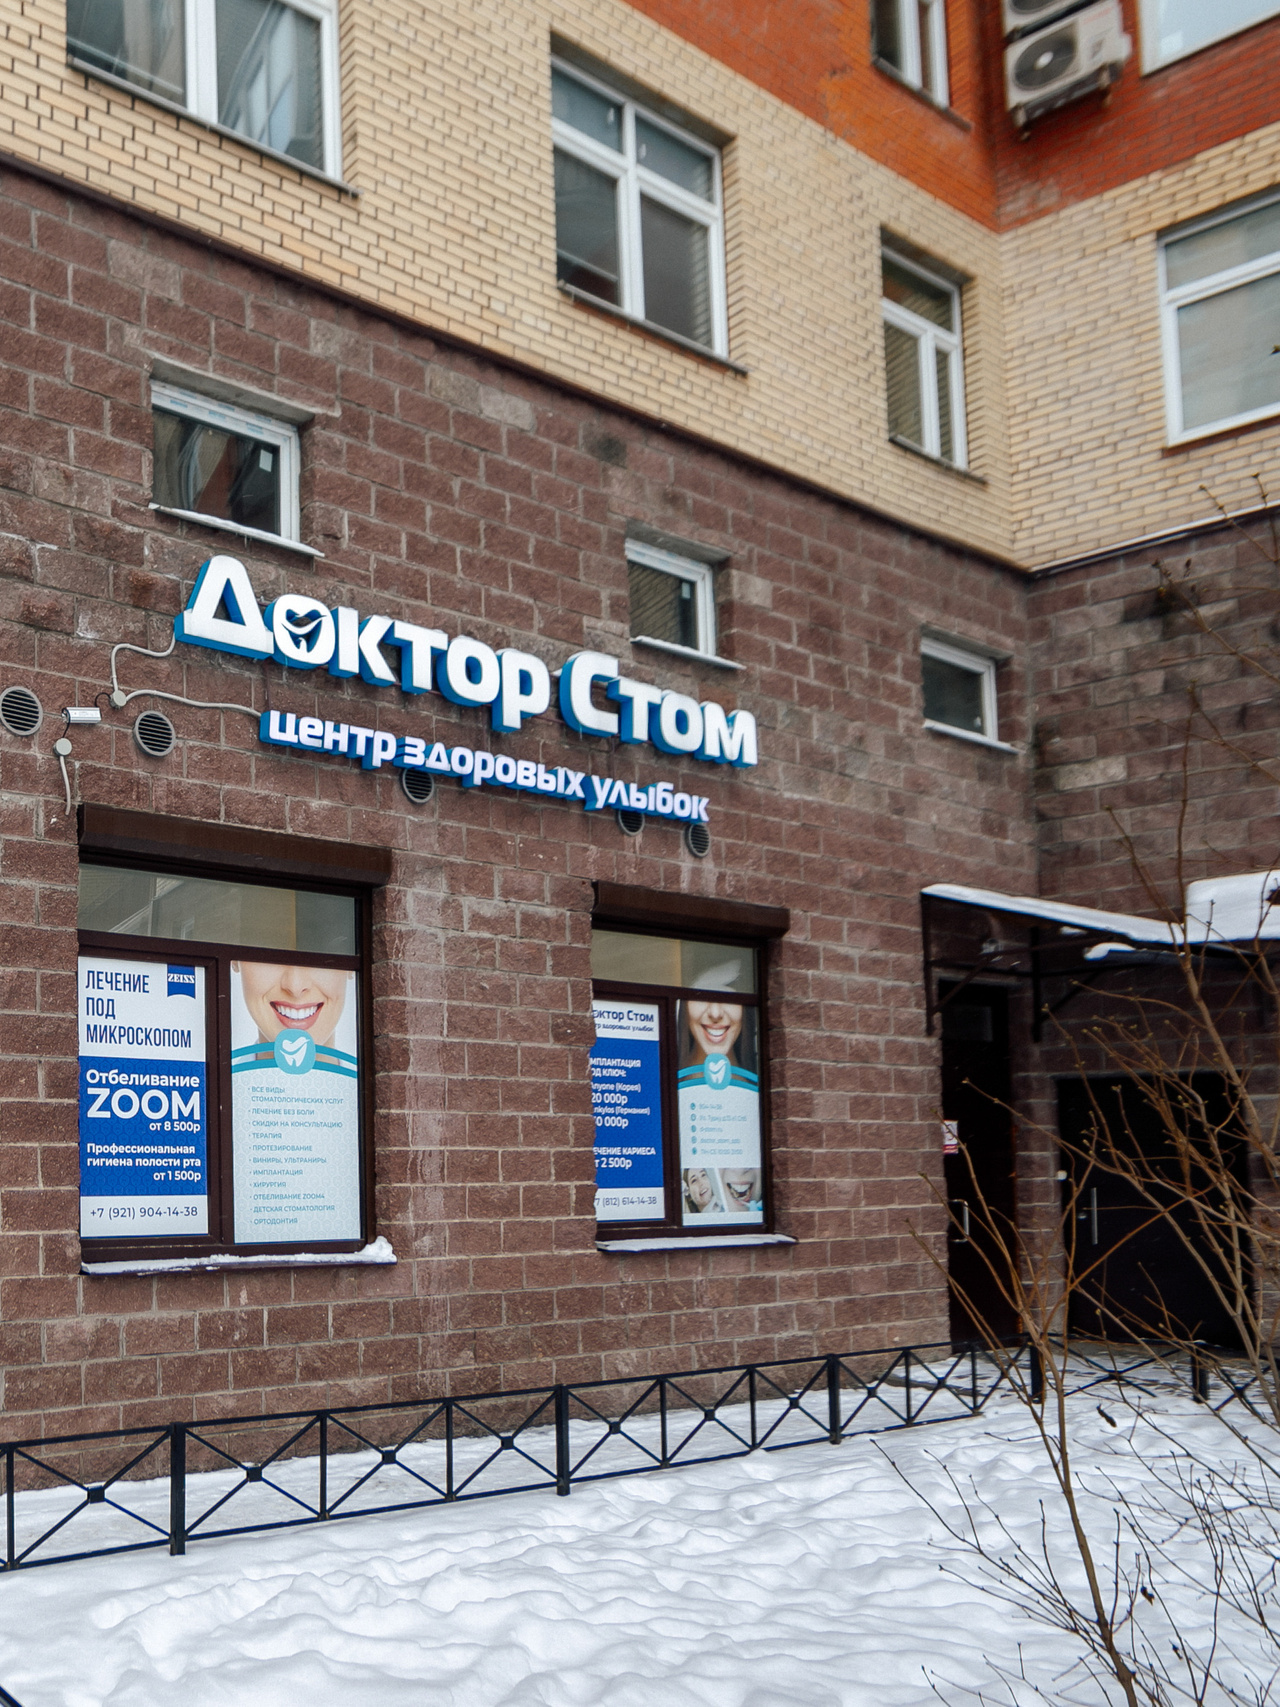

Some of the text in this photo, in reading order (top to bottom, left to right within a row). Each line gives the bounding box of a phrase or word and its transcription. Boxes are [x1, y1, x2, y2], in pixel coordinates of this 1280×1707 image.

[176, 555, 758, 768] Доктор Стом
[262, 709, 710, 823] центр здоровых улыбок
[85, 970, 150, 993] ЛЕЧЕНИЕ
[167, 973, 195, 984] ZEISS
[86, 997, 116, 1020] ПОД
[591, 1010, 654, 1022] октор Стом
[86, 1024, 192, 1048] МИКРОСКОПОМ
[590, 1057, 641, 1068] МПЛАНТАЦИЯ
[86, 1069, 200, 1087] Отбеливание
[87, 1087, 201, 1120] ZOOM
[251, 1096, 324, 1104] СТОМАТОЛОГИЧЕСКИХ
[593, 1106, 615, 1115] nkylos
[149, 1121, 201, 1134] от 8 500р
[86, 1143, 195, 1155] Профессиональная
[592, 1147, 656, 1155] ЕЧЕНИЕ КАРИЕСА
[86, 1158, 201, 1168] гигиена полости рта
[153, 1171, 201, 1182] от 1 500р
[90, 1206, 198, 1220] +7 (921) 904-14-38
